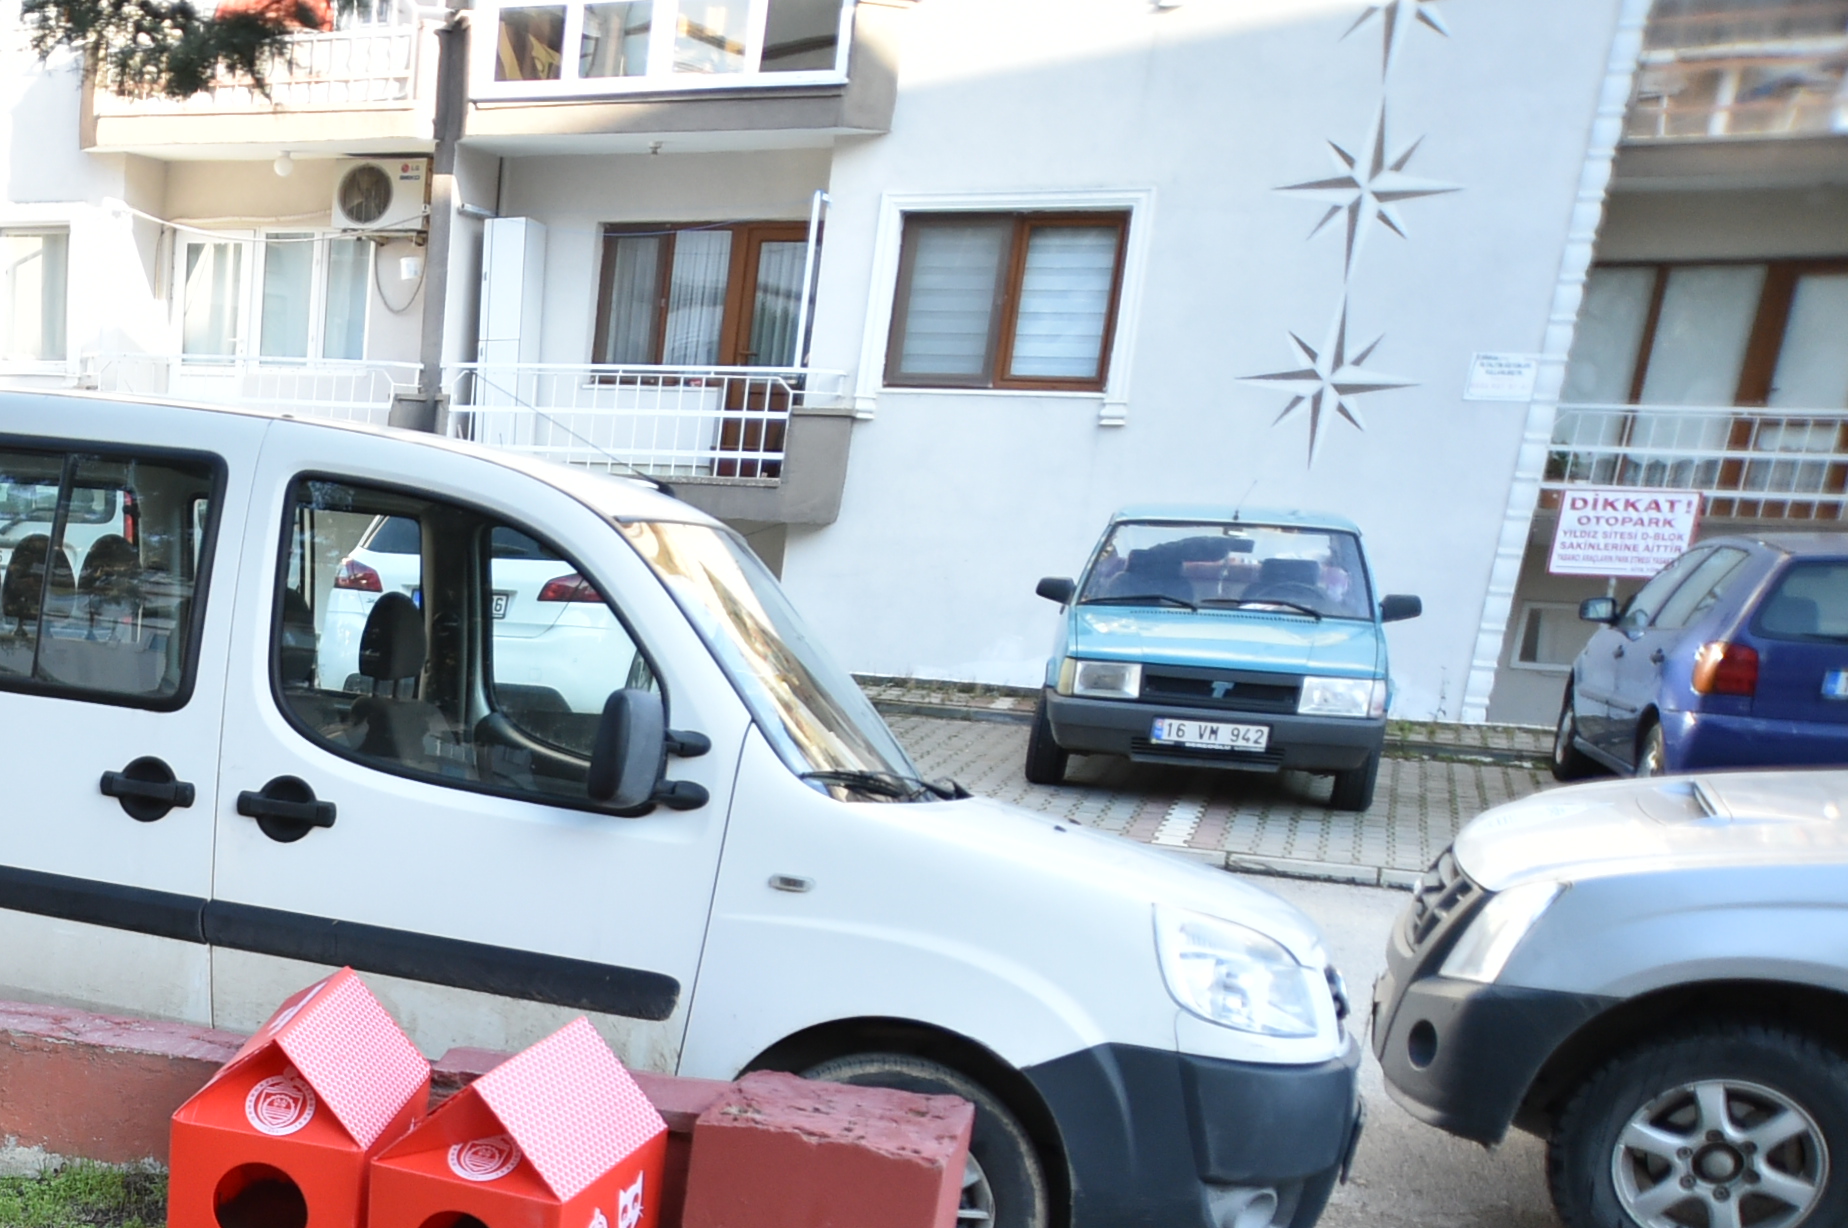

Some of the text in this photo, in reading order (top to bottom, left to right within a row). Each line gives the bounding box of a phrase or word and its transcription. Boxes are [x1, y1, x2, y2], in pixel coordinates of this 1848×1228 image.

[1570, 493, 1693, 514] DİKKAT!
[1577, 515, 1676, 528] OTOPARK
[1562, 529, 1685, 542] YILDIZ SİTESİ D-BLOK
[1560, 540, 1641, 552] SAKİNLERİNE
[1167, 722, 1265, 745] 16 VM 942
